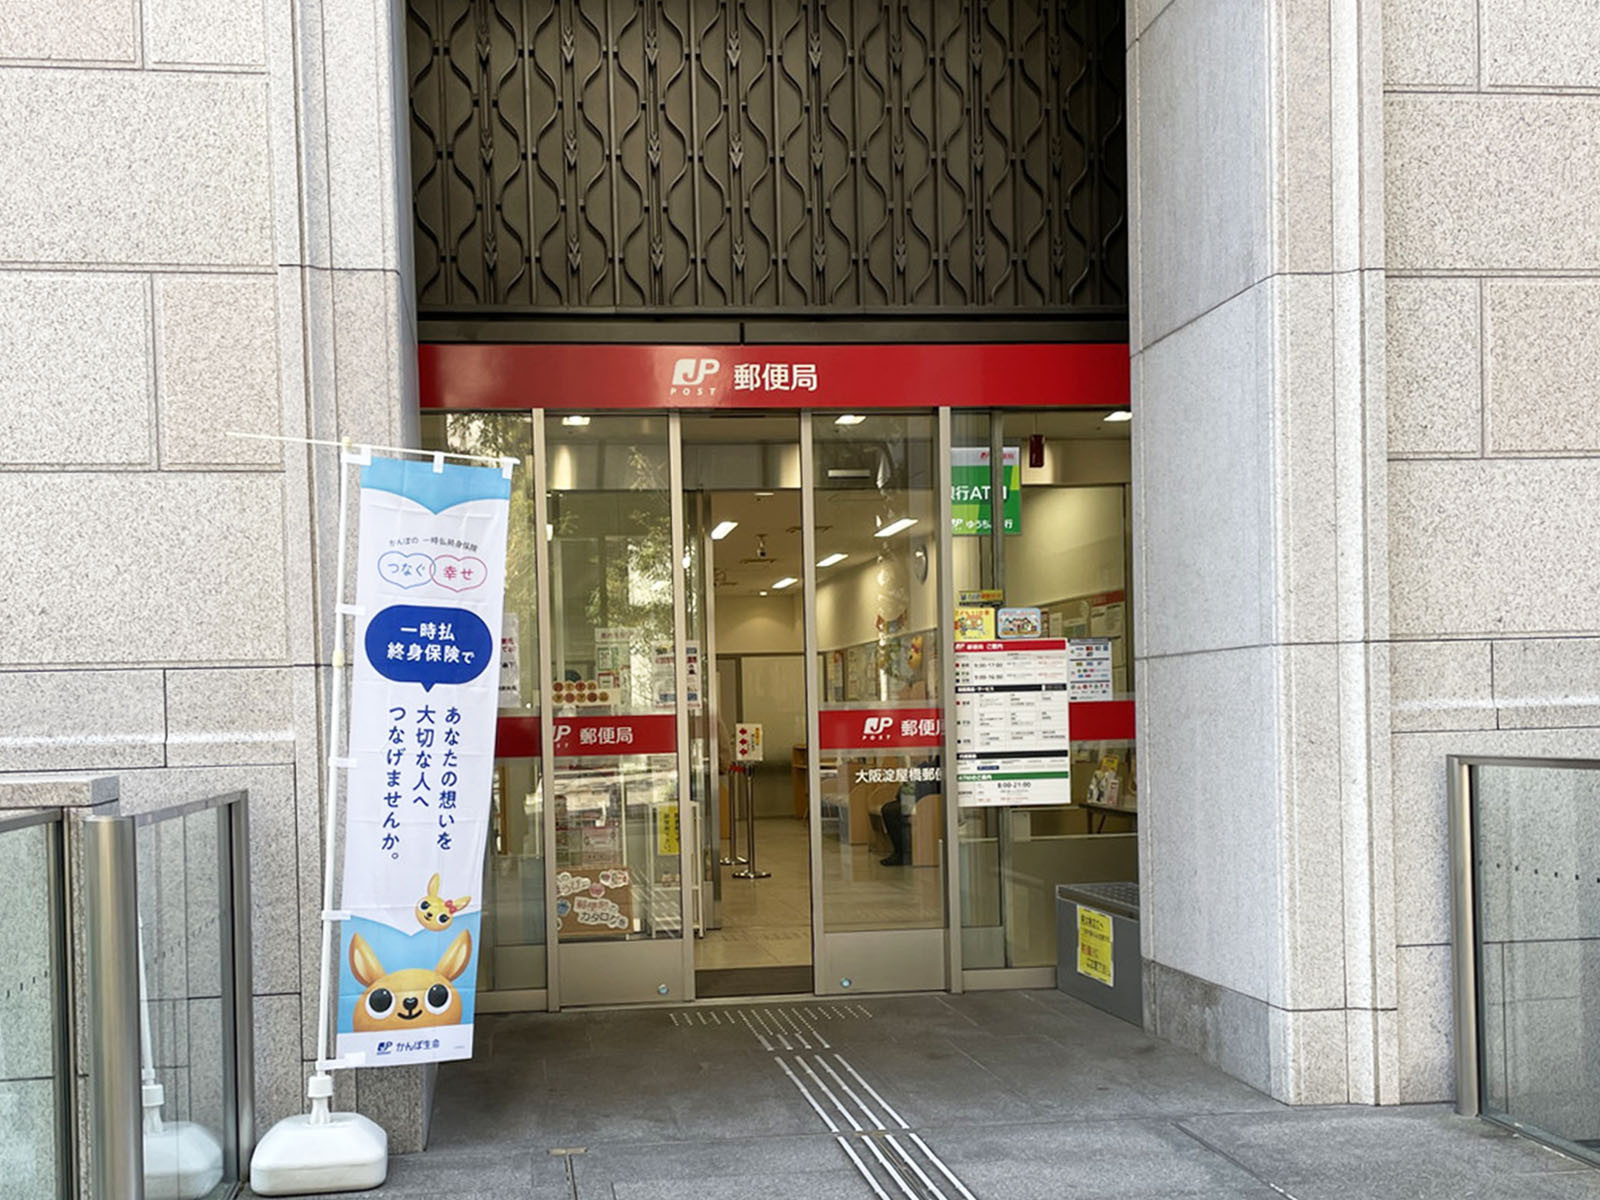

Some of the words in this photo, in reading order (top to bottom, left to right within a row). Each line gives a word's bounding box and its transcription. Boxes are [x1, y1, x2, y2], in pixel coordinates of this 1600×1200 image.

[672, 359, 720, 385] JP
[734, 363, 818, 391] 郵便局
[670, 387, 717, 396] POST
[387, 562, 426, 577] つなぐ
[444, 565, 474, 581] 幸せ
[401, 621, 456, 641] 一時払
[386, 642, 476, 664] 終身保険で
[579, 726, 633, 745] 郵便局
[864, 717, 893, 735] JP
[412, 704, 436, 808] 大切な人へ
[380, 706, 407, 860] つなげませんか。
[437, 706, 462, 851] あなたの想いを
